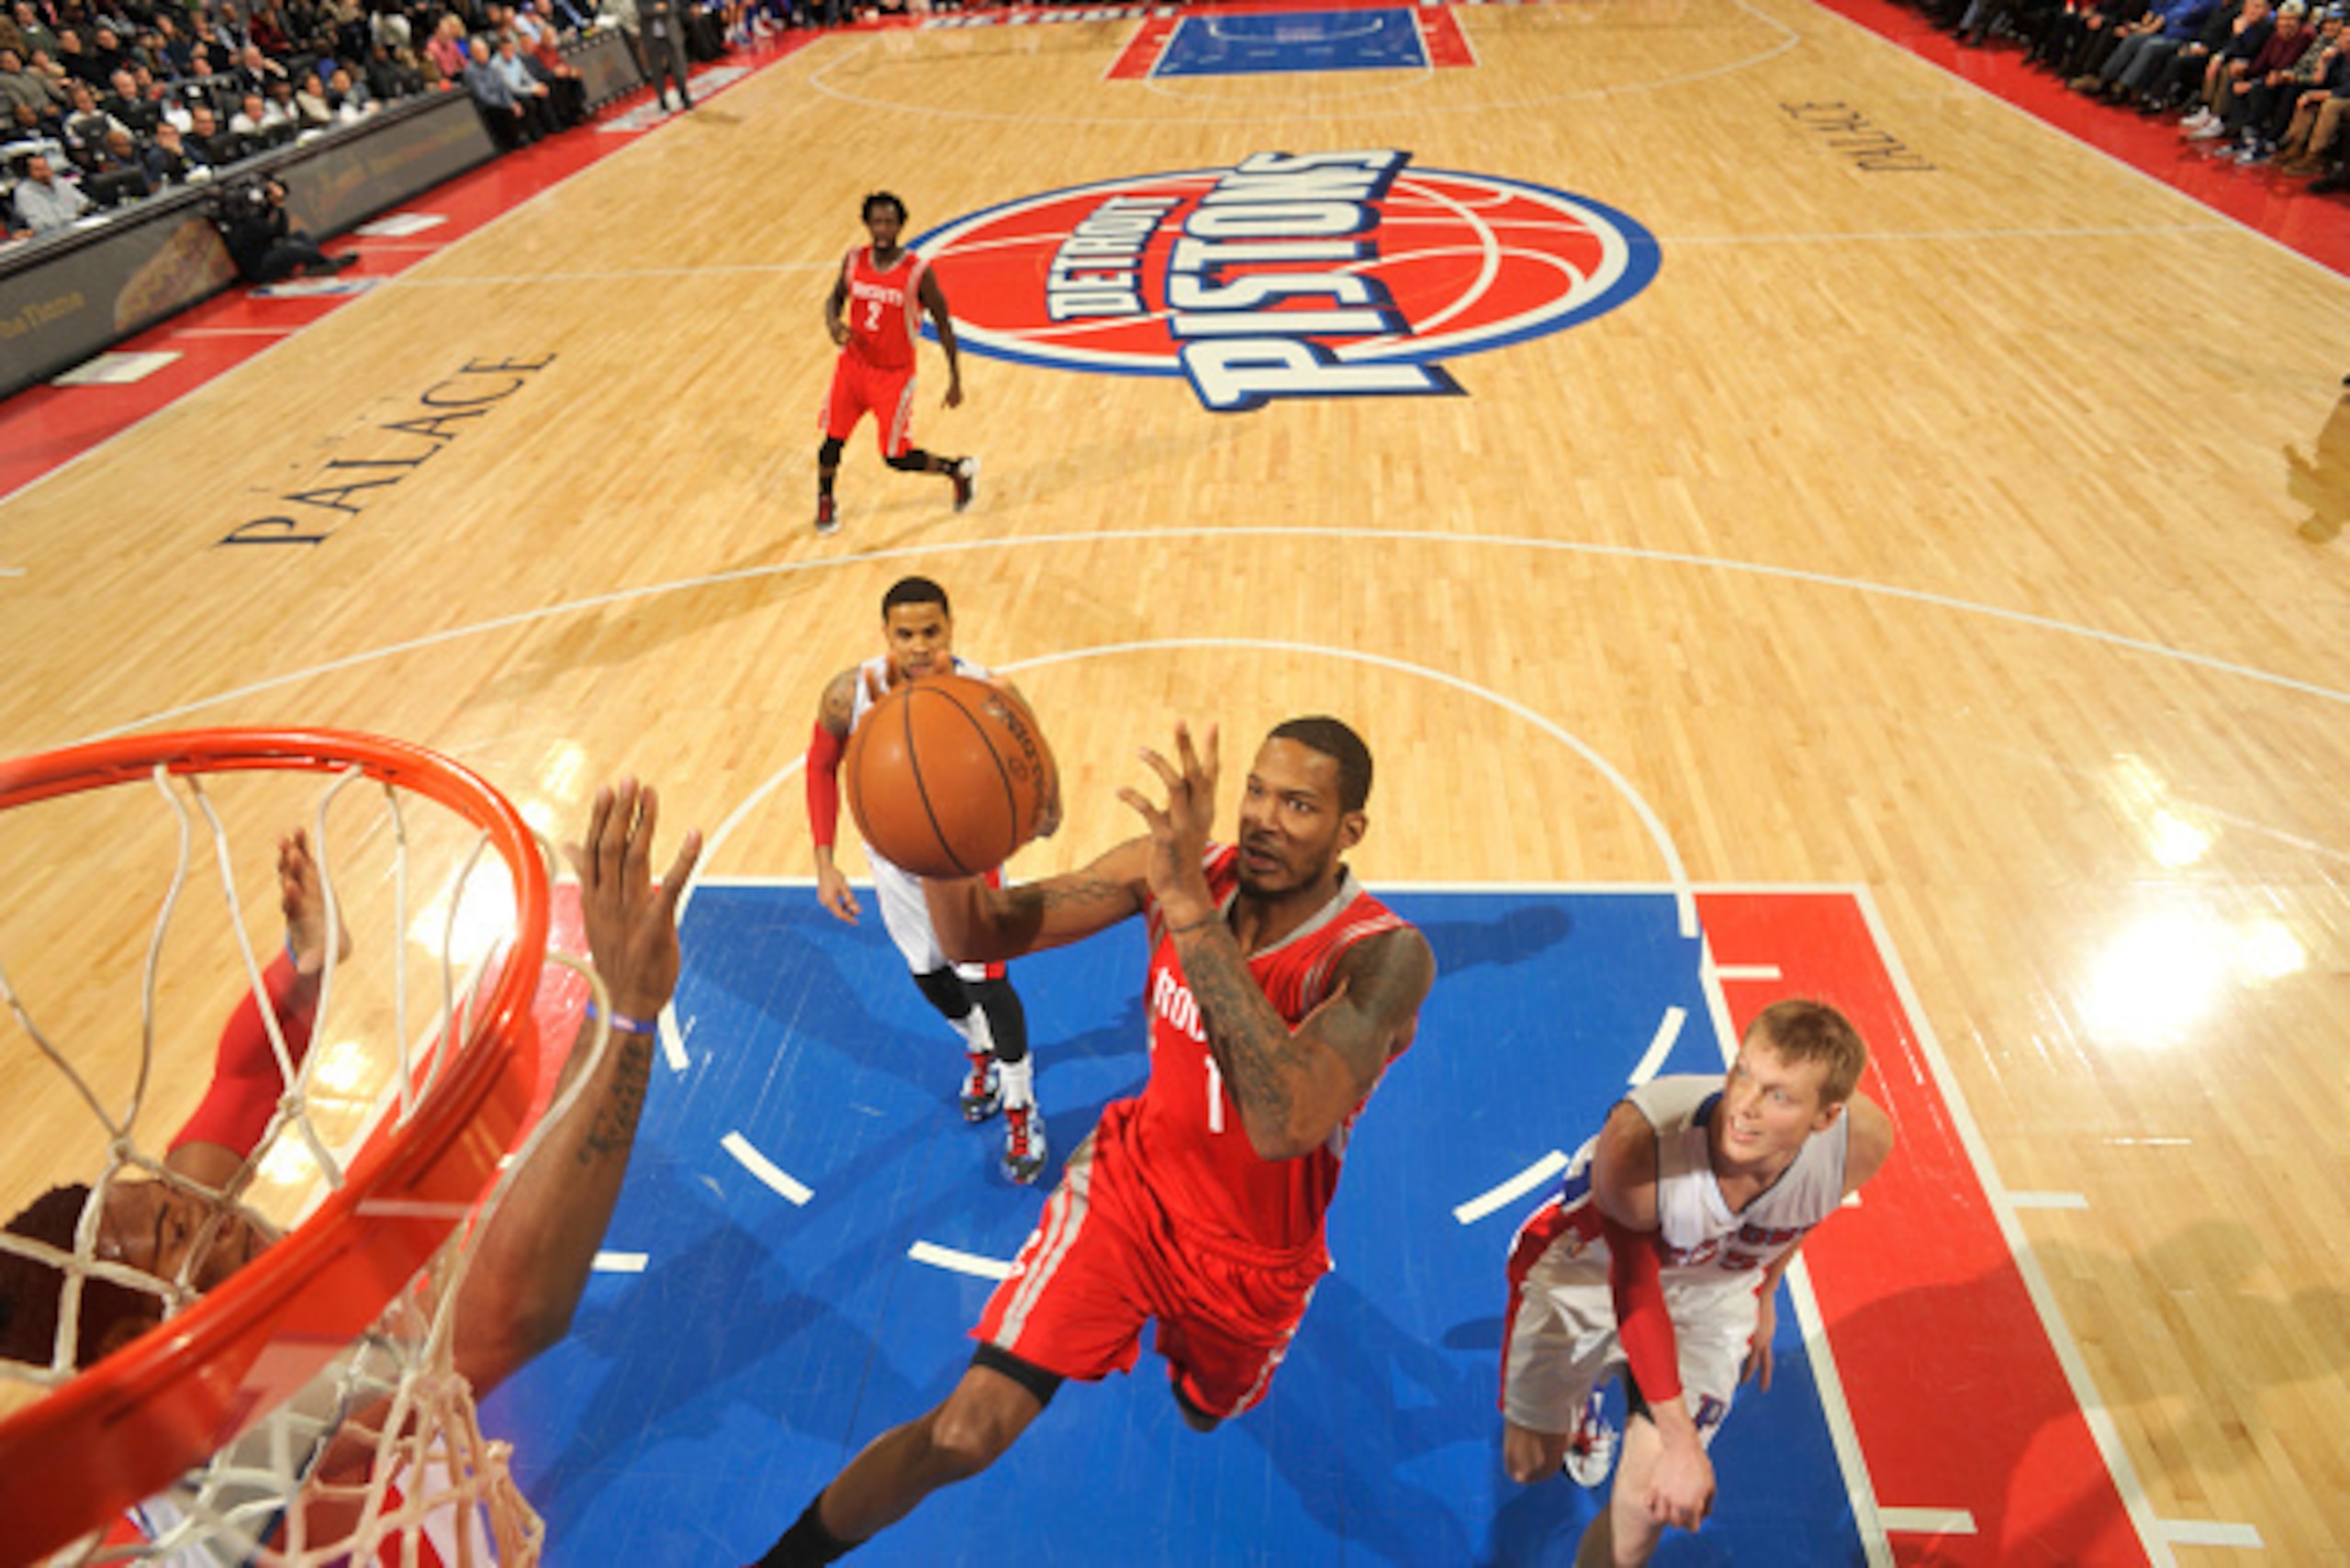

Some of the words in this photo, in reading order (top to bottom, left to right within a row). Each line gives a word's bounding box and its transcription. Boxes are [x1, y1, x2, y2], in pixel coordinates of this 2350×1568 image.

[864, 301, 882, 331] 2
[1046, 195, 1186, 321] DETROIT
[1165, 150, 1470, 412] PISTONS
[218, 353, 558, 546] PALACE
[1205, 1055, 1225, 1134] 1
